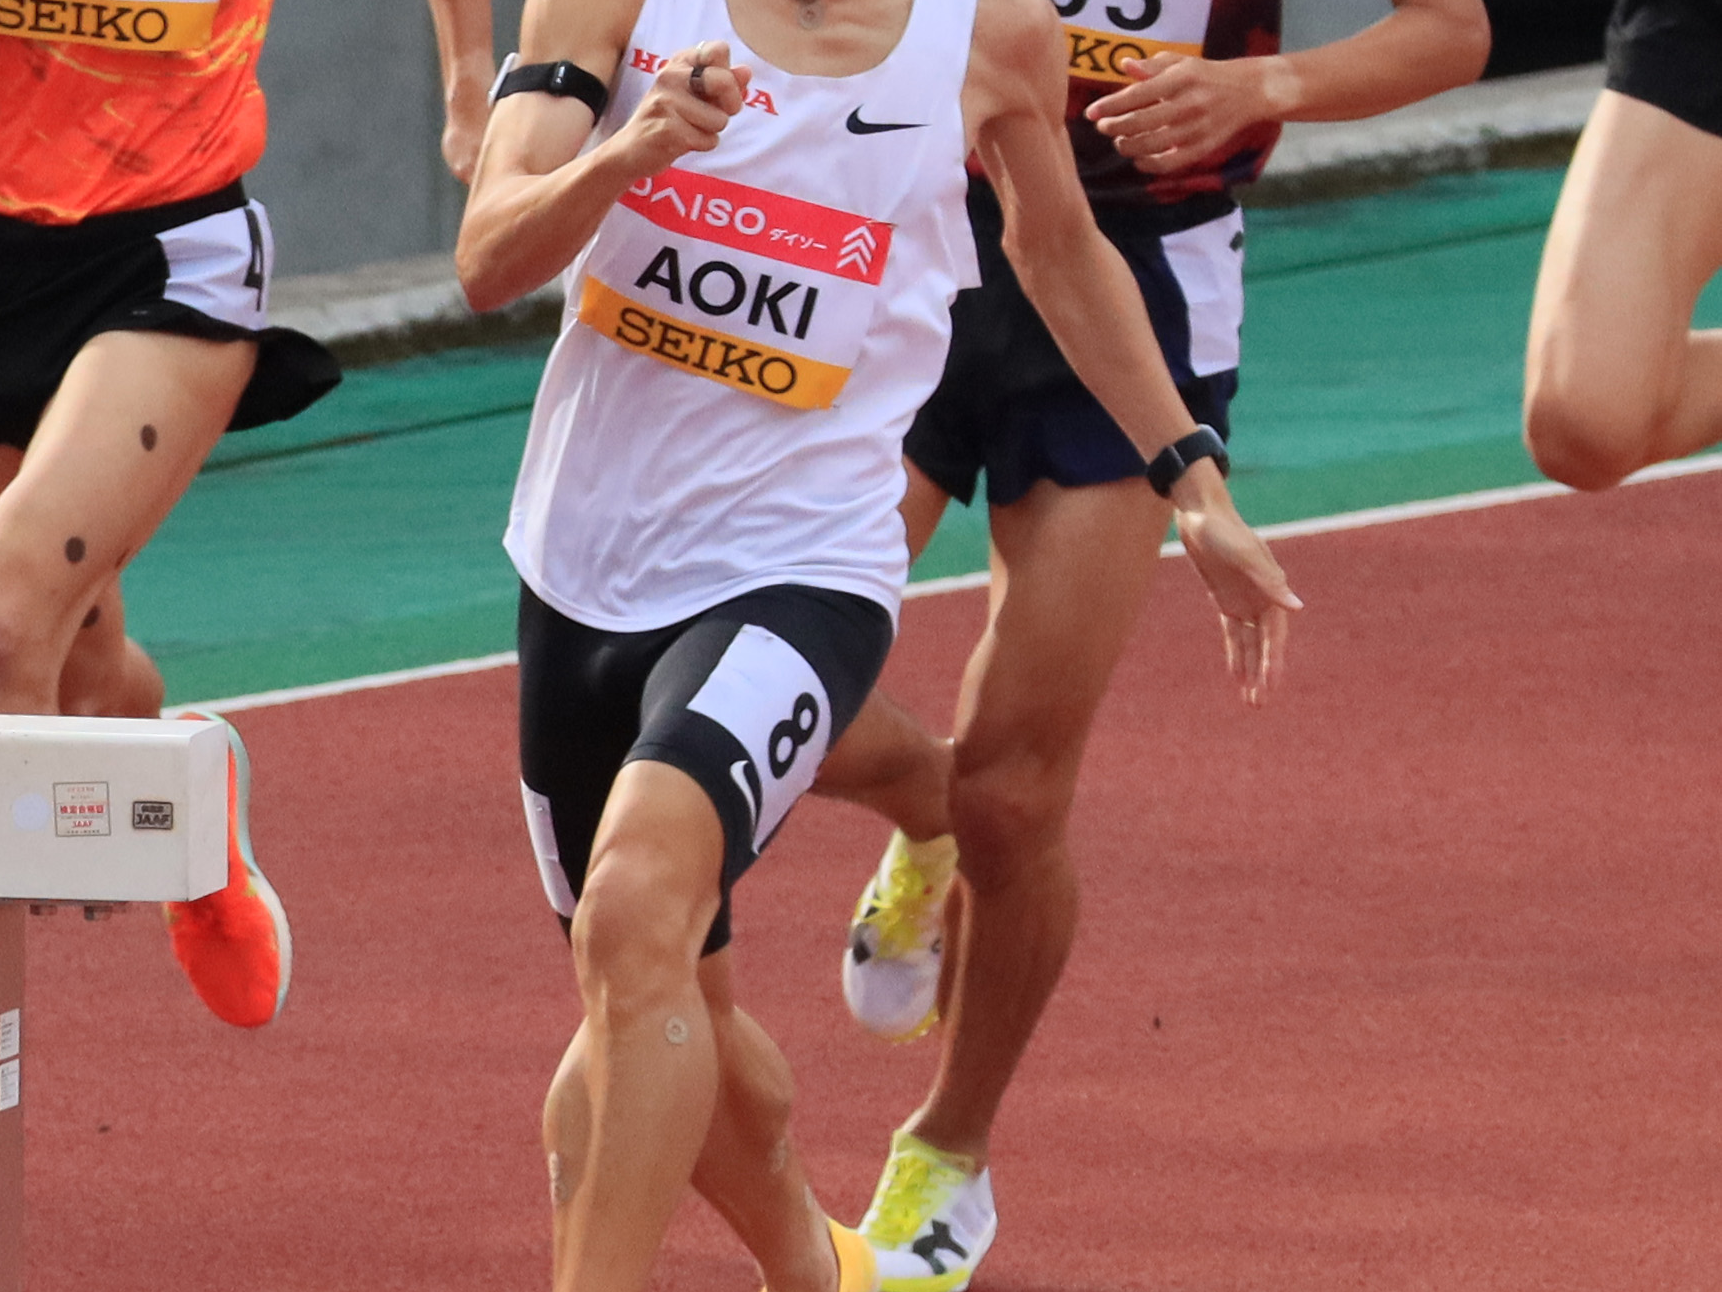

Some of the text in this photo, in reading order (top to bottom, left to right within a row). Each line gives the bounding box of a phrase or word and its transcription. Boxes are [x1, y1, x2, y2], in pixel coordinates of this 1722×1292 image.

[635, 245, 819, 340] AOKI
[615, 306, 797, 395] SEIKO
[768, 692, 819, 780] 8
[136, 813, 171, 826] JAAF
